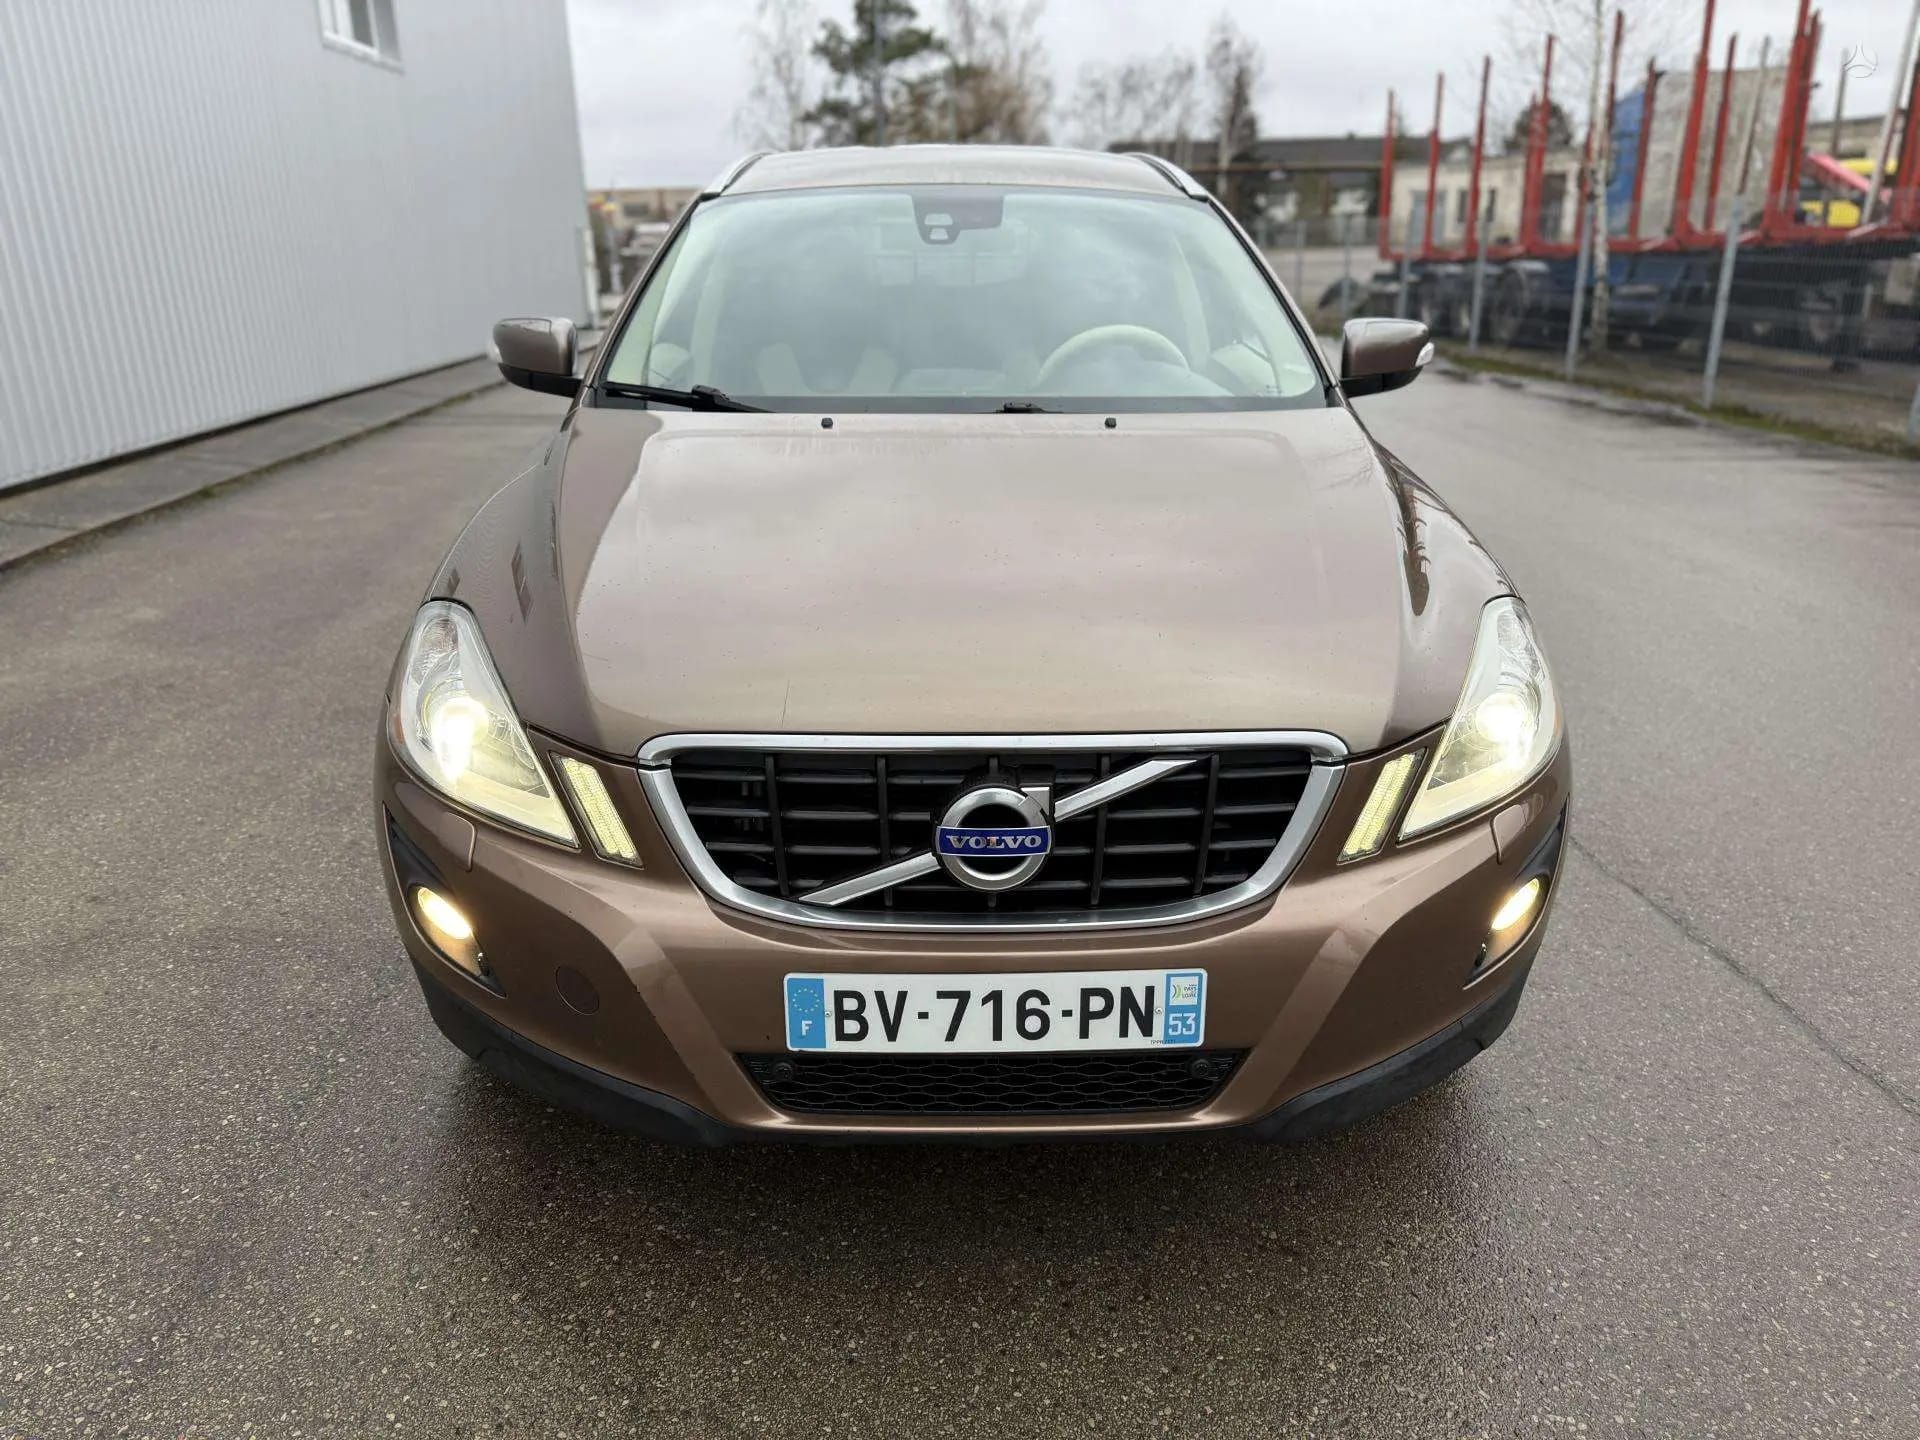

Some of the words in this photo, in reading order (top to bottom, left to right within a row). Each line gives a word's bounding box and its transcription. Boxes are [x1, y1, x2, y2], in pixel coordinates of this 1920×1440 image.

[946, 835, 1041, 849] VOLVO
[834, 985, 1155, 1042] BV-716-PN
[801, 1019, 813, 1036] F
[1168, 1012, 1196, 1036] 53
